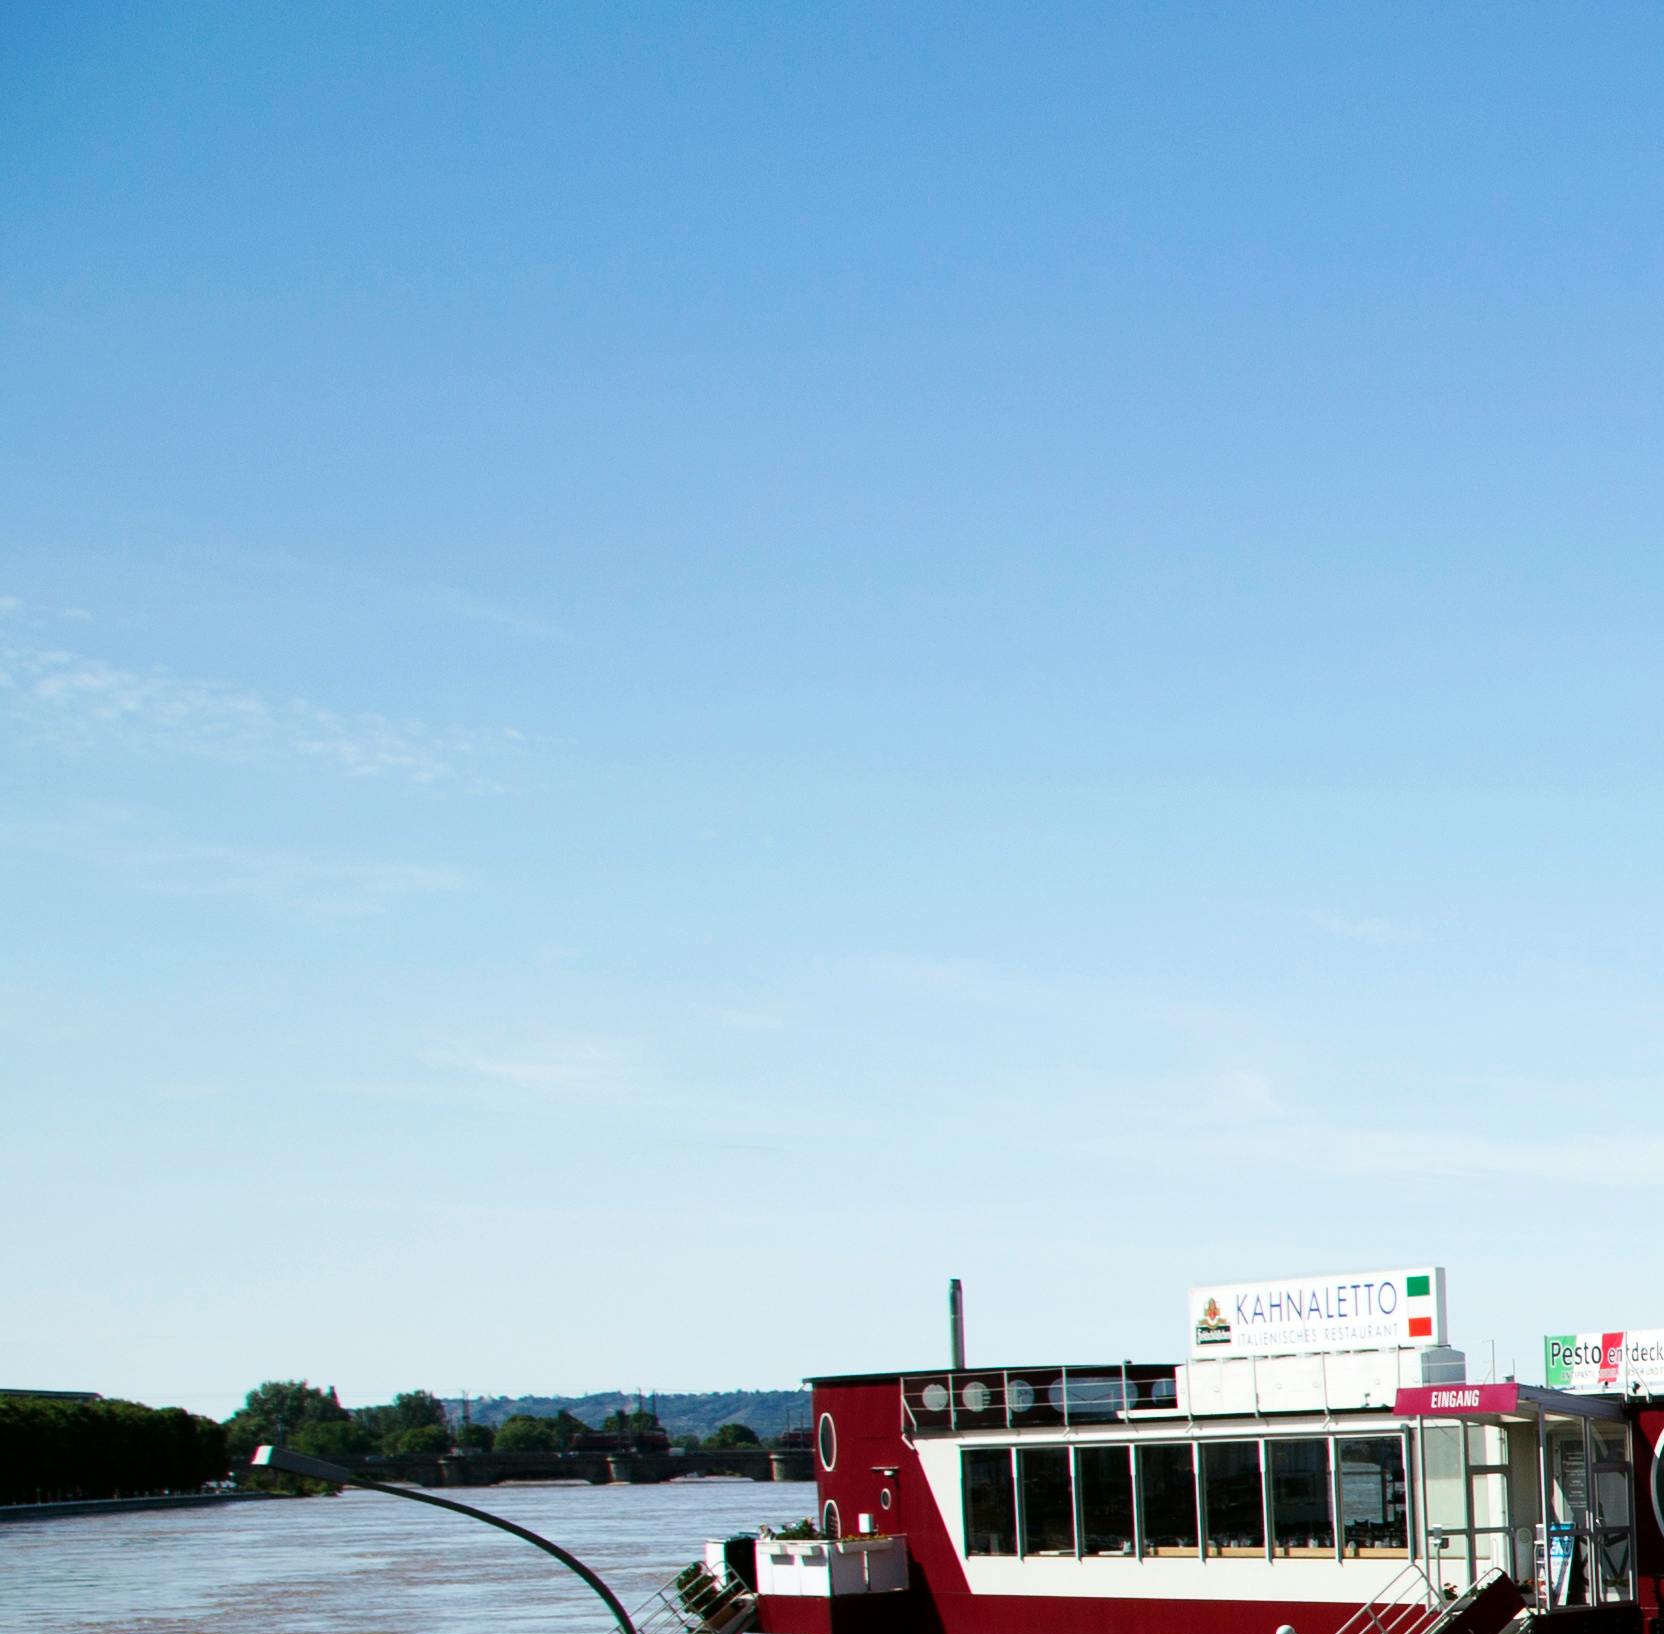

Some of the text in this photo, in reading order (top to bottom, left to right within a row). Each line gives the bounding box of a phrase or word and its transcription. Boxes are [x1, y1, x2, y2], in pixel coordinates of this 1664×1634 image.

[1236, 1282, 1397, 1325] KAHNALETTO
[1237, 1326, 1318, 1348] ITALIENISCHES
[1324, 1322, 1399, 1341] RESTAURANT
[1550, 1341, 1602, 1367] Pesto
[1431, 1389, 1480, 1408] EINGANG
